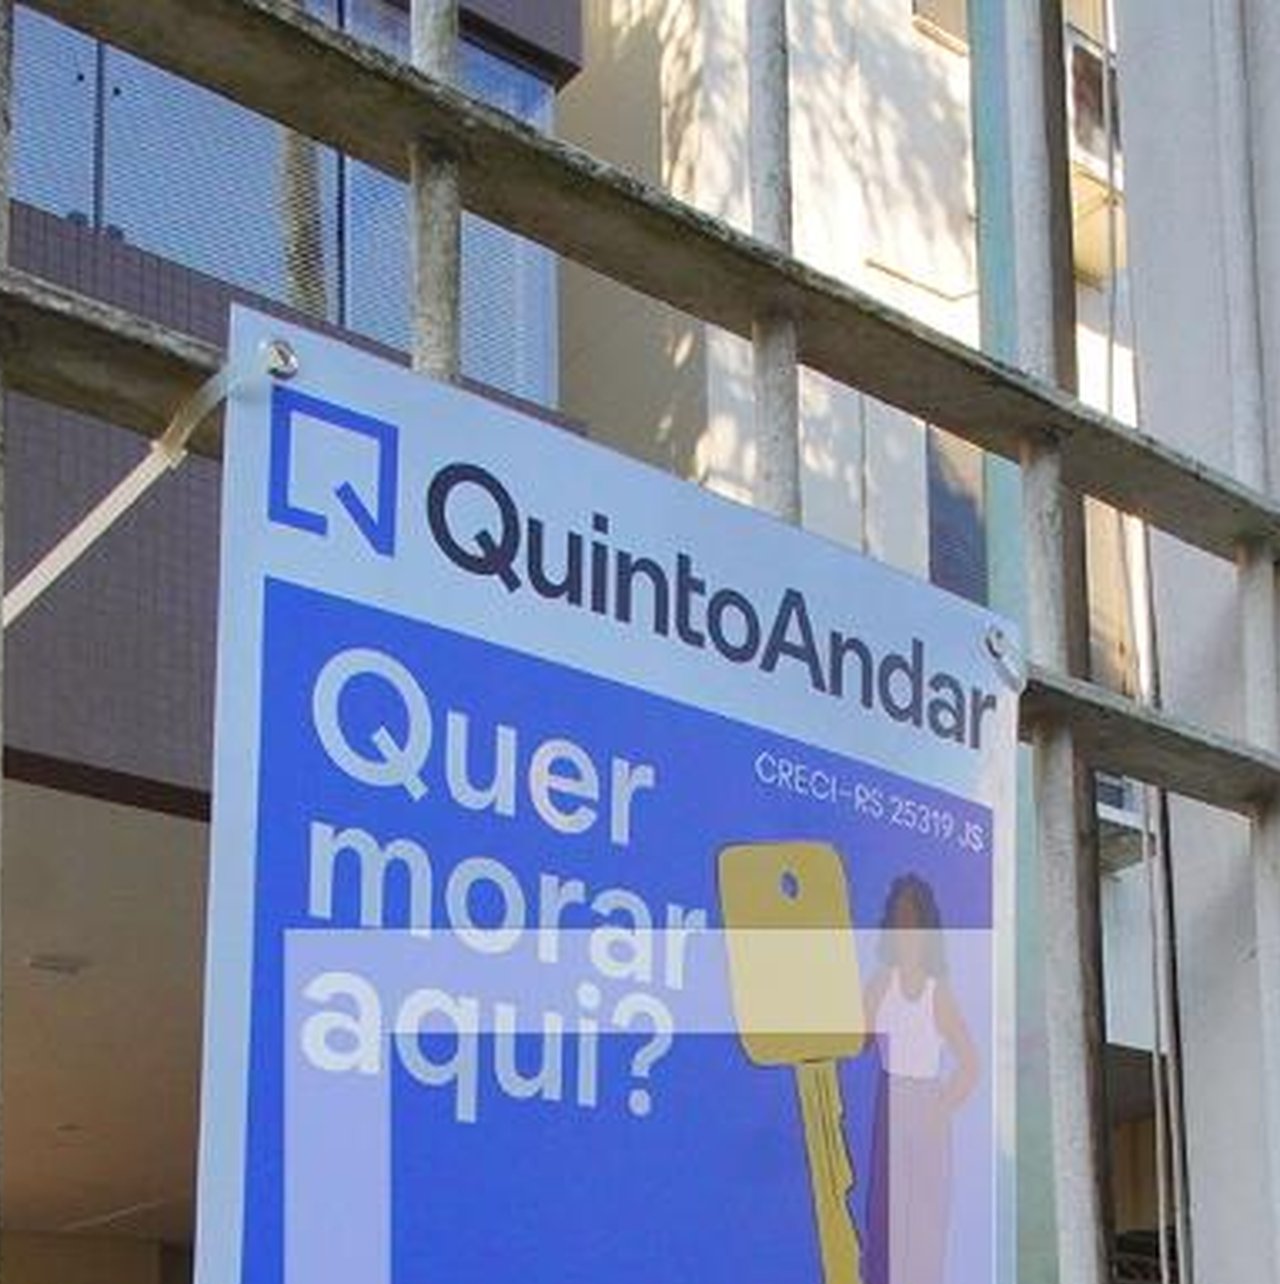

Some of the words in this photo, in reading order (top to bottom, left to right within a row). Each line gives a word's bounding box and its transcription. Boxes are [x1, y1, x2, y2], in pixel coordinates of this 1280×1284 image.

[426, 462, 996, 750] QuintoAndar
[311, 647, 657, 847] Quer
[307, 819, 706, 991] morar
[298, 967, 676, 1123] aqui?
